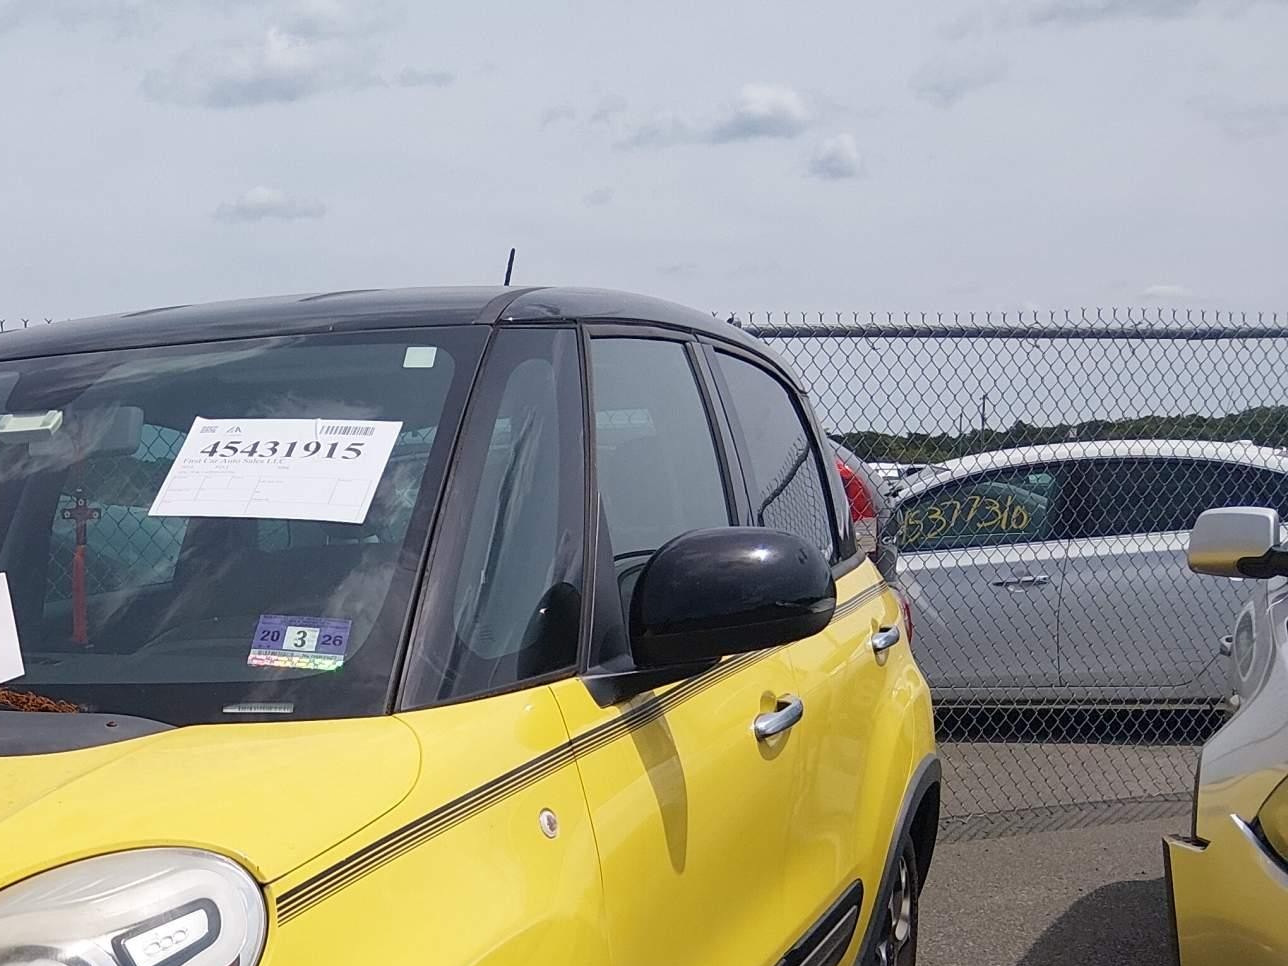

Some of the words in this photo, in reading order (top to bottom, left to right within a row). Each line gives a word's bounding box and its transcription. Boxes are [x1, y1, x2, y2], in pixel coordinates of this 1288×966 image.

[200, 440, 365, 460] 45431915
[260, 630, 280, 642] 20
[293, 630, 307, 648] 3
[321, 634, 343, 646] 26
